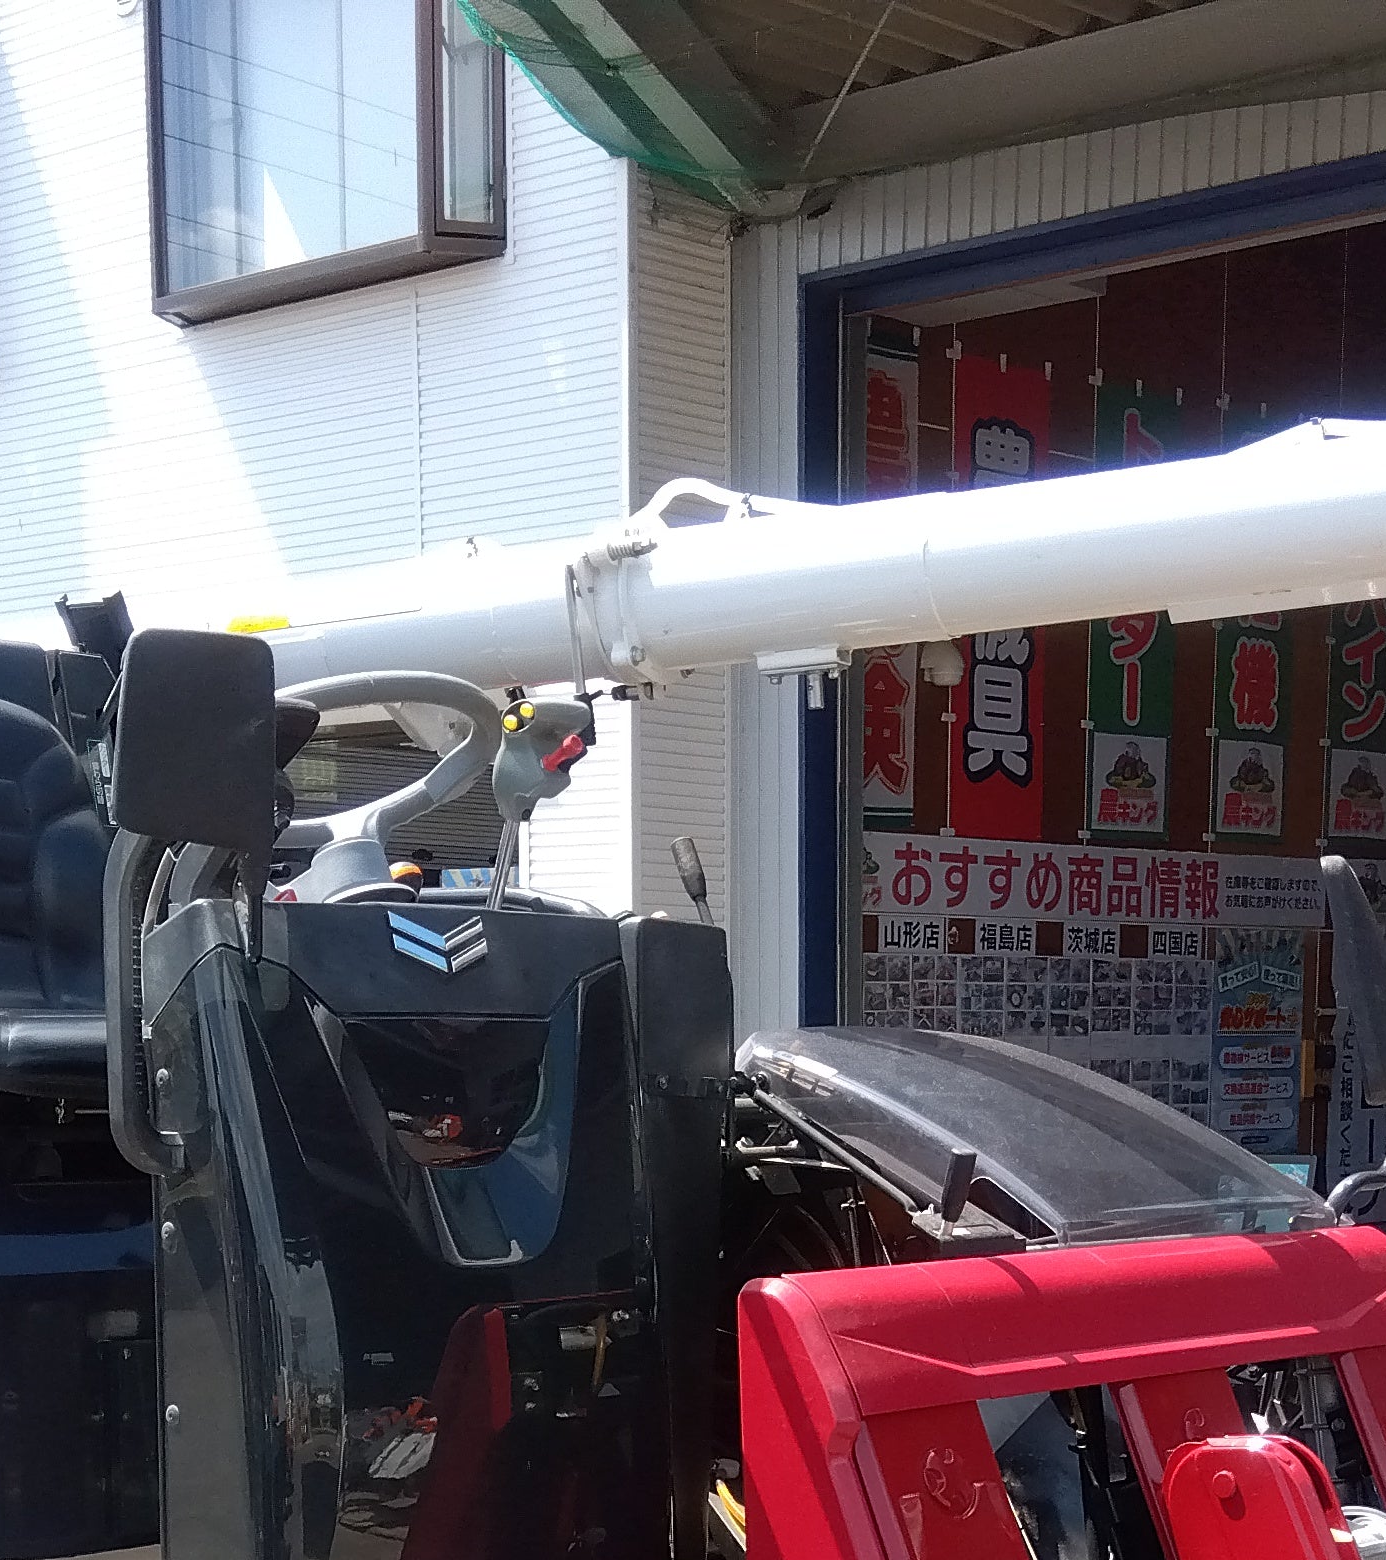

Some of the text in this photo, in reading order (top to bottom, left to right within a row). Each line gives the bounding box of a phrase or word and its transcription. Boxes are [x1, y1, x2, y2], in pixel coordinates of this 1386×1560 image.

[891, 841, 1221, 920] おすすめ商品情報
[883, 920, 940, 950] 山形店
[979, 924, 1033, 952] 福島店
[1066, 927, 1117, 954] 茨城店
[1152, 930, 1199, 957] 四国店
